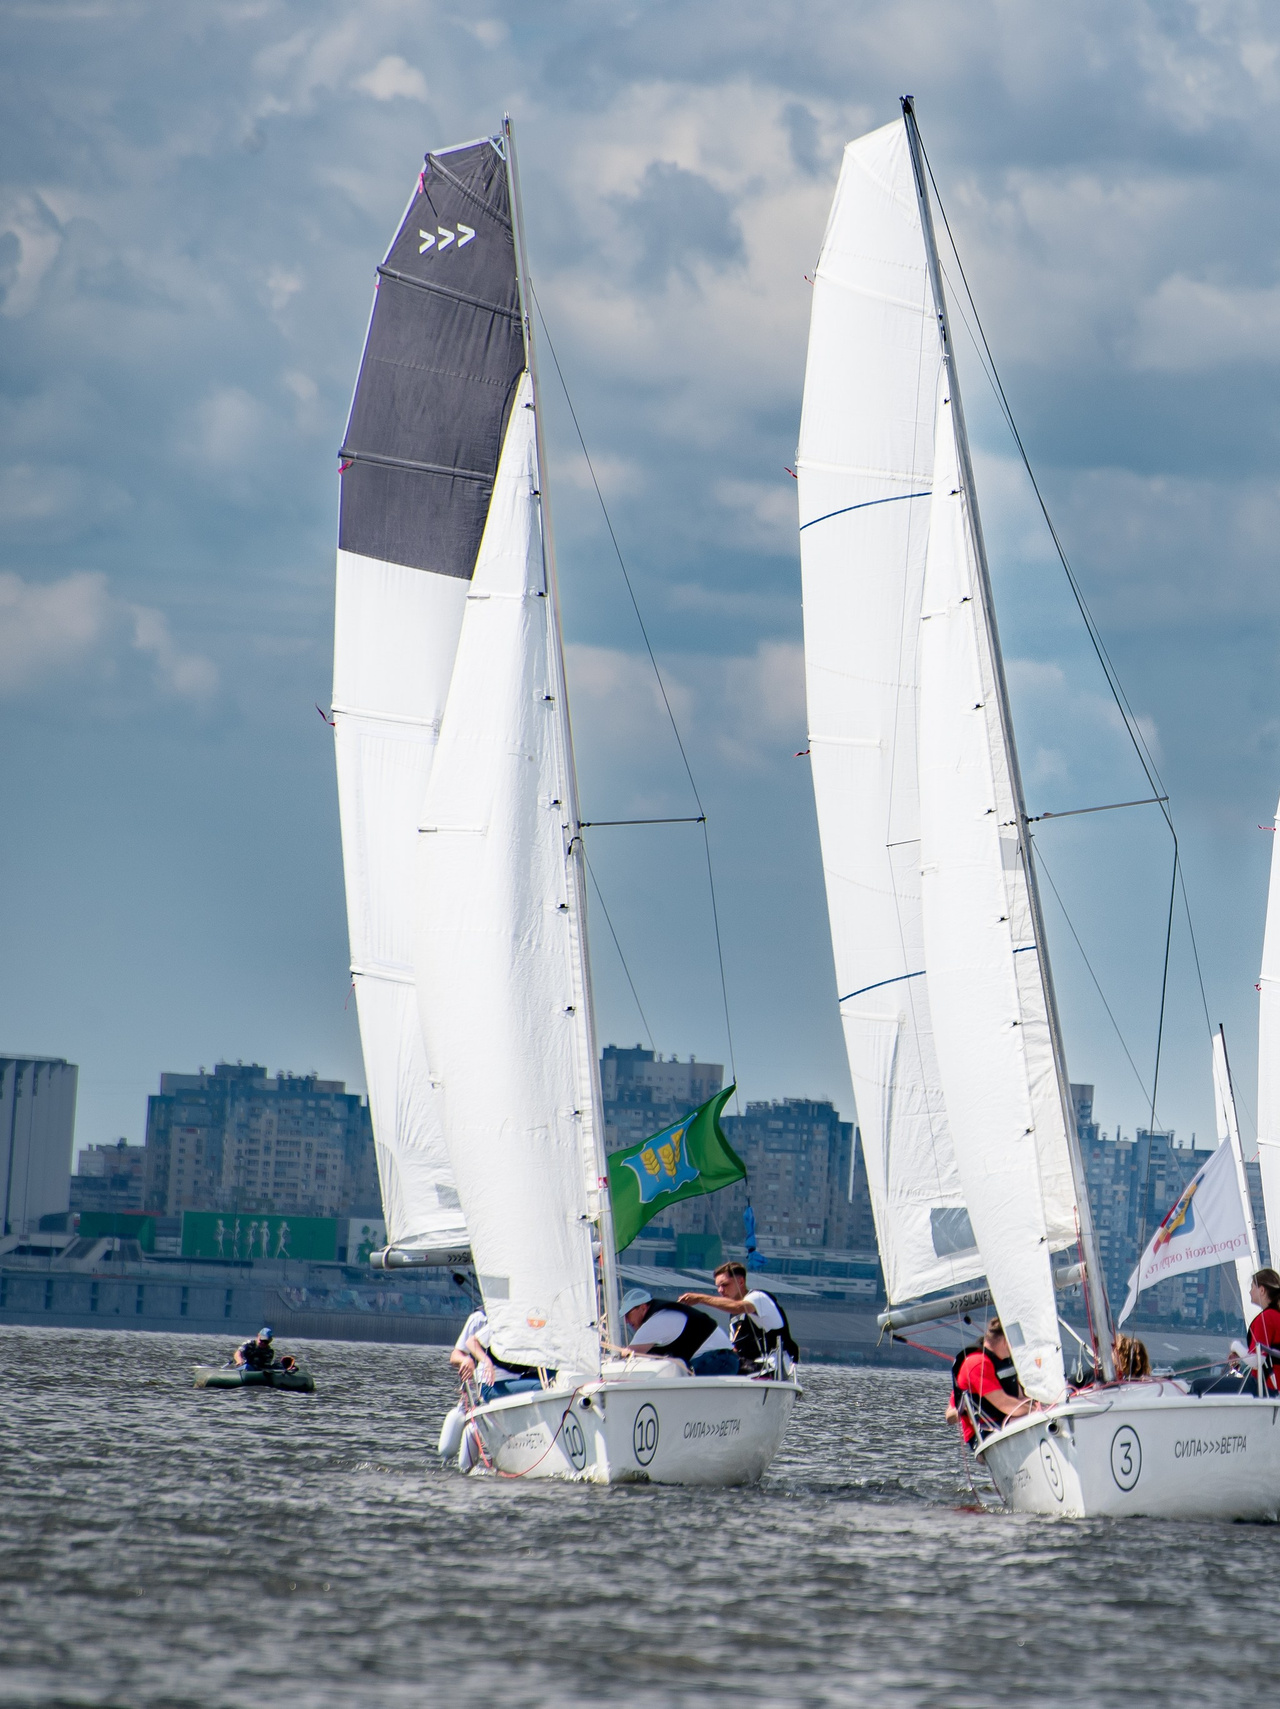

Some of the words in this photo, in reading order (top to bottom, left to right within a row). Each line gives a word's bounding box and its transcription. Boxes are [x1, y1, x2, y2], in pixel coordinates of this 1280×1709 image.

[565, 1425, 583, 1457] 10
[637, 1419, 656, 1452] 10
[1120, 1442, 1133, 1475] 3
